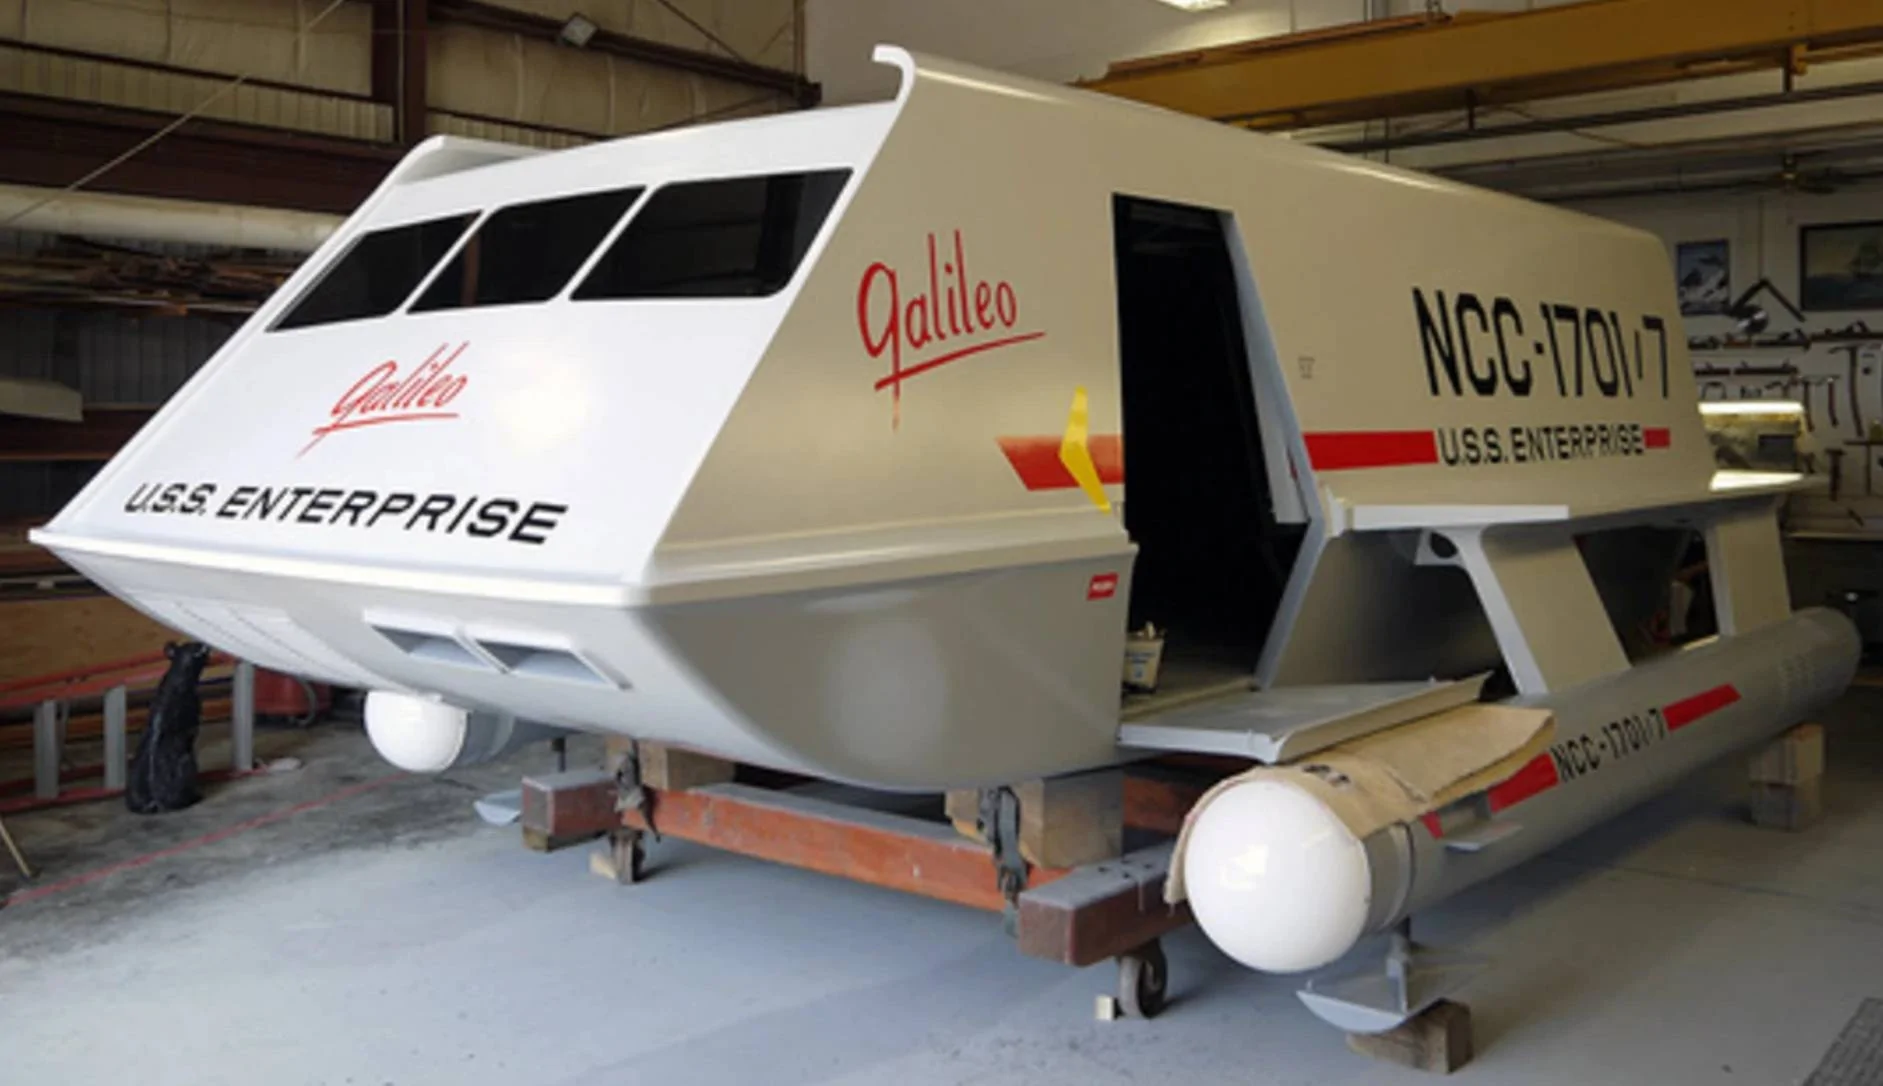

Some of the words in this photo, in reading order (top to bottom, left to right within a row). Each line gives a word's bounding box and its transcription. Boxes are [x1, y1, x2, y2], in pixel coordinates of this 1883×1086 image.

[1438, 426, 1509, 465] U.S.S.
[1511, 424, 1644, 463] ENTERPRISE
[124, 482, 216, 513] U.S.S.
[216, 486, 568, 545] ENTERPRISE
